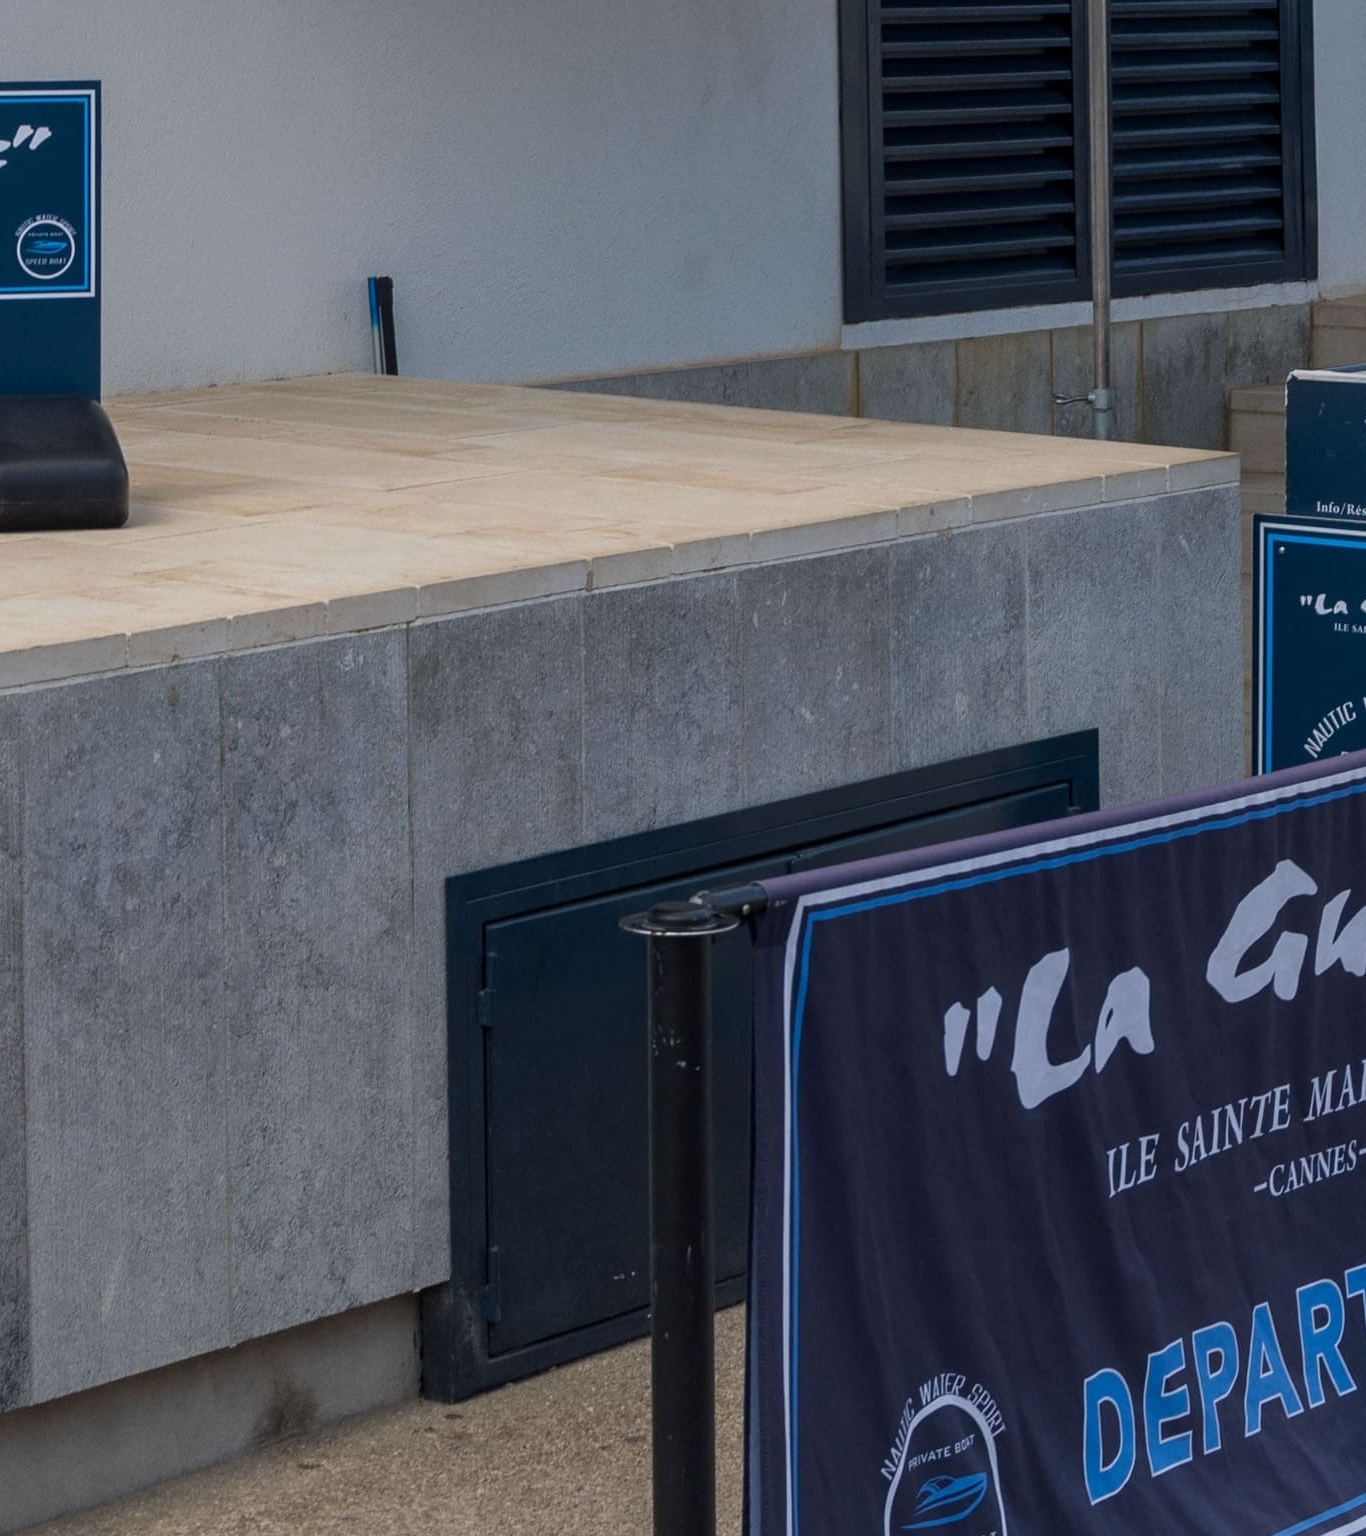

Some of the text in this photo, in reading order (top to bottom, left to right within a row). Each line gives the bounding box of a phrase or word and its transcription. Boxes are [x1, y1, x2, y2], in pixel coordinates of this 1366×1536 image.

[1300, 593, 1348, 615] "La
[1334, 622, 1349, 633] ILE
[1303, 701, 1357, 758] NAUTIC
[943, 946, 1155, 1110] "La
[1106, 1132, 1160, 1198] ILE
[1172, 1083, 1291, 1174] SAINTE
[880, 1373, 1006, 1481] NAUTIC WATER SPORT
[908, 1434, 975, 1472] PRIVATE BOAT
